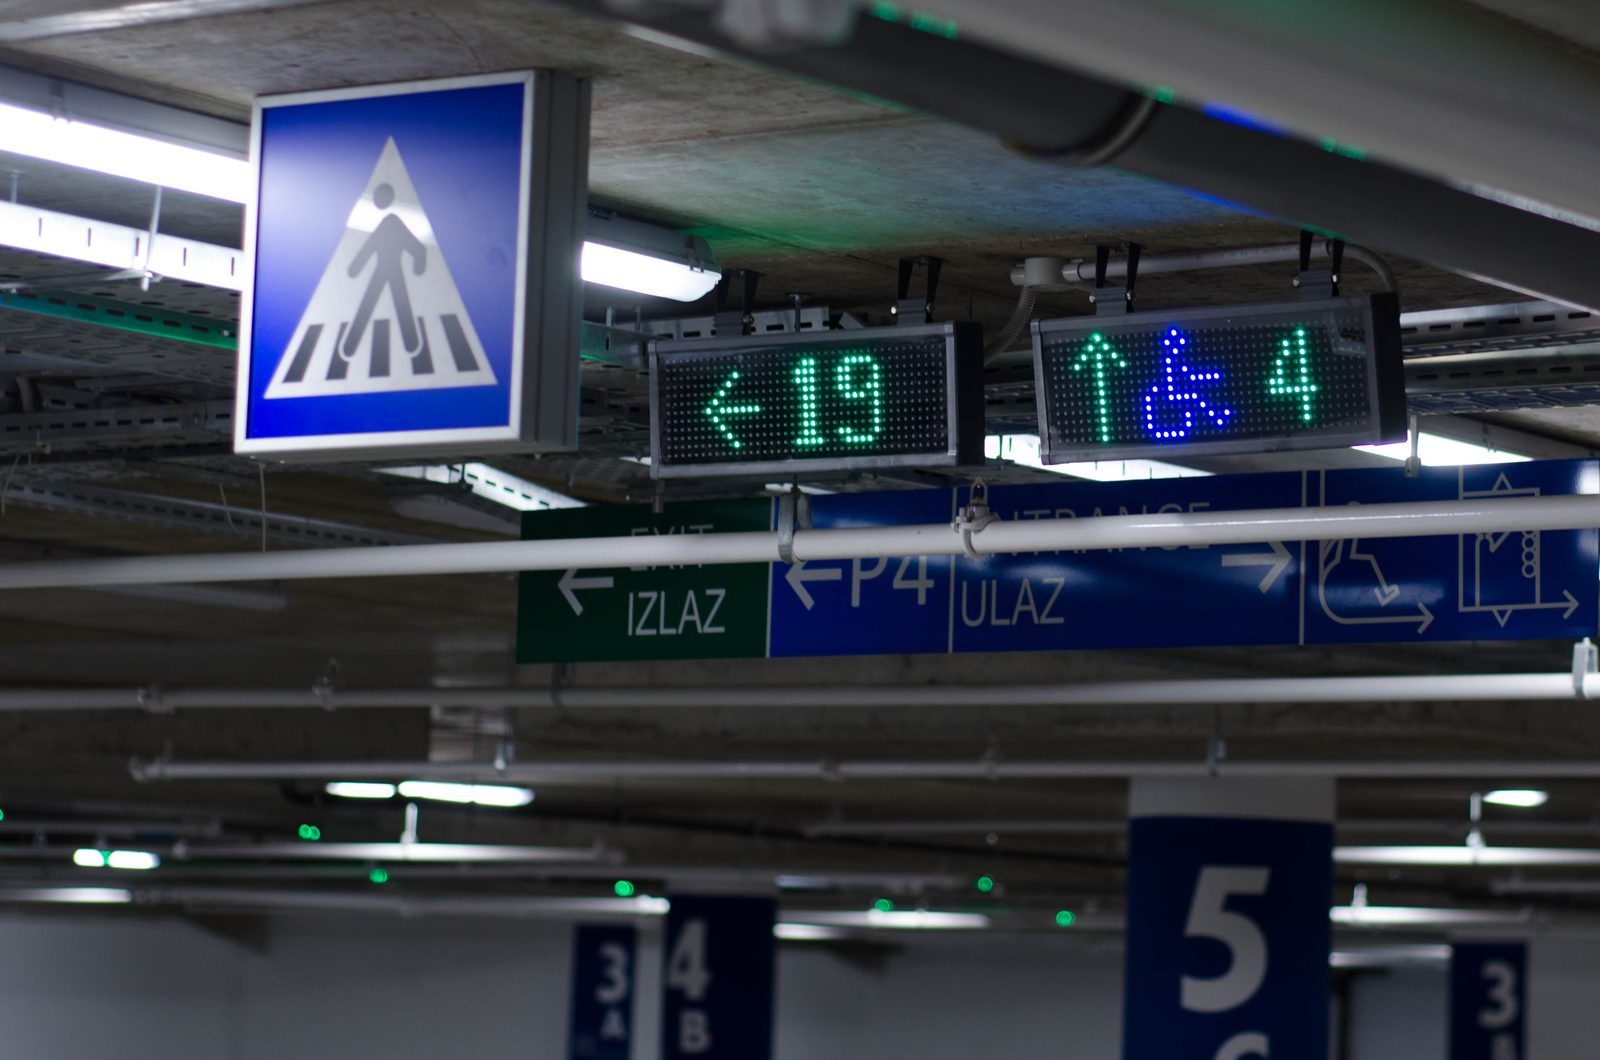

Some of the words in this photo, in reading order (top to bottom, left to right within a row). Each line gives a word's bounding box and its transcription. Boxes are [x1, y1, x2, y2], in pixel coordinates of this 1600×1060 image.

[793, 354, 882, 446] 19
[1268, 326, 1319, 422] 4
[628, 588, 726, 636] IZLAZ
[961, 576, 1065, 627] ULAZ
[595, 942, 628, 1003] 3
[668, 919, 711, 999] 4
[1180, 866, 1271, 1014] 5
[1476, 958, 1520, 1029] 3
[680, 1009, 711, 1052] B
